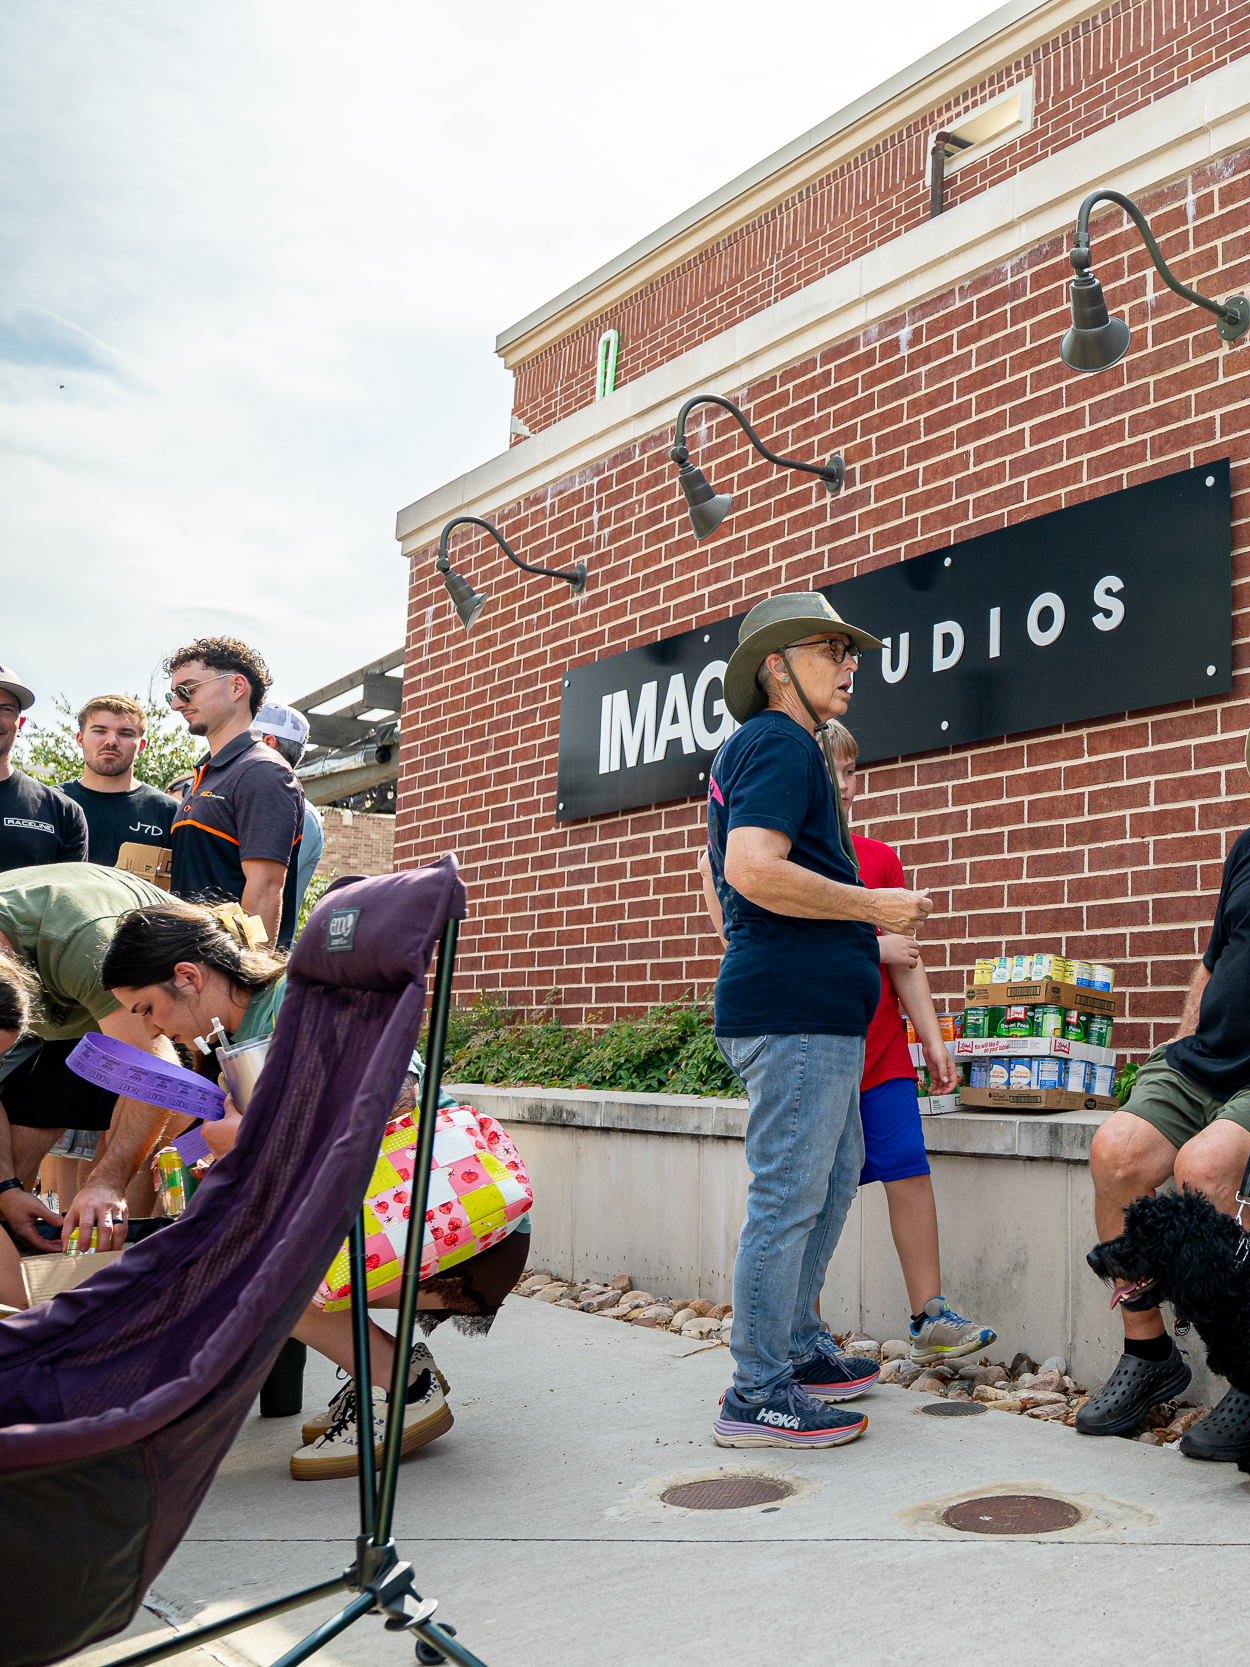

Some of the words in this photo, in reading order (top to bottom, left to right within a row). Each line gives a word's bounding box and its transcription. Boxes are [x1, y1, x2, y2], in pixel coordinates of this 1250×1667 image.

[599, 660, 743, 775] IMAG
[847, 575, 1125, 694] UDIOS
[7, 819, 53, 832] RACELINE
[129, 821, 163, 836] J7D
[91, 1072, 111, 1085] TICKET
[119, 1083, 140, 1095] TICKET
[147, 1092, 166, 1103] TICKET
[756, 1408, 800, 1430] HOKA
